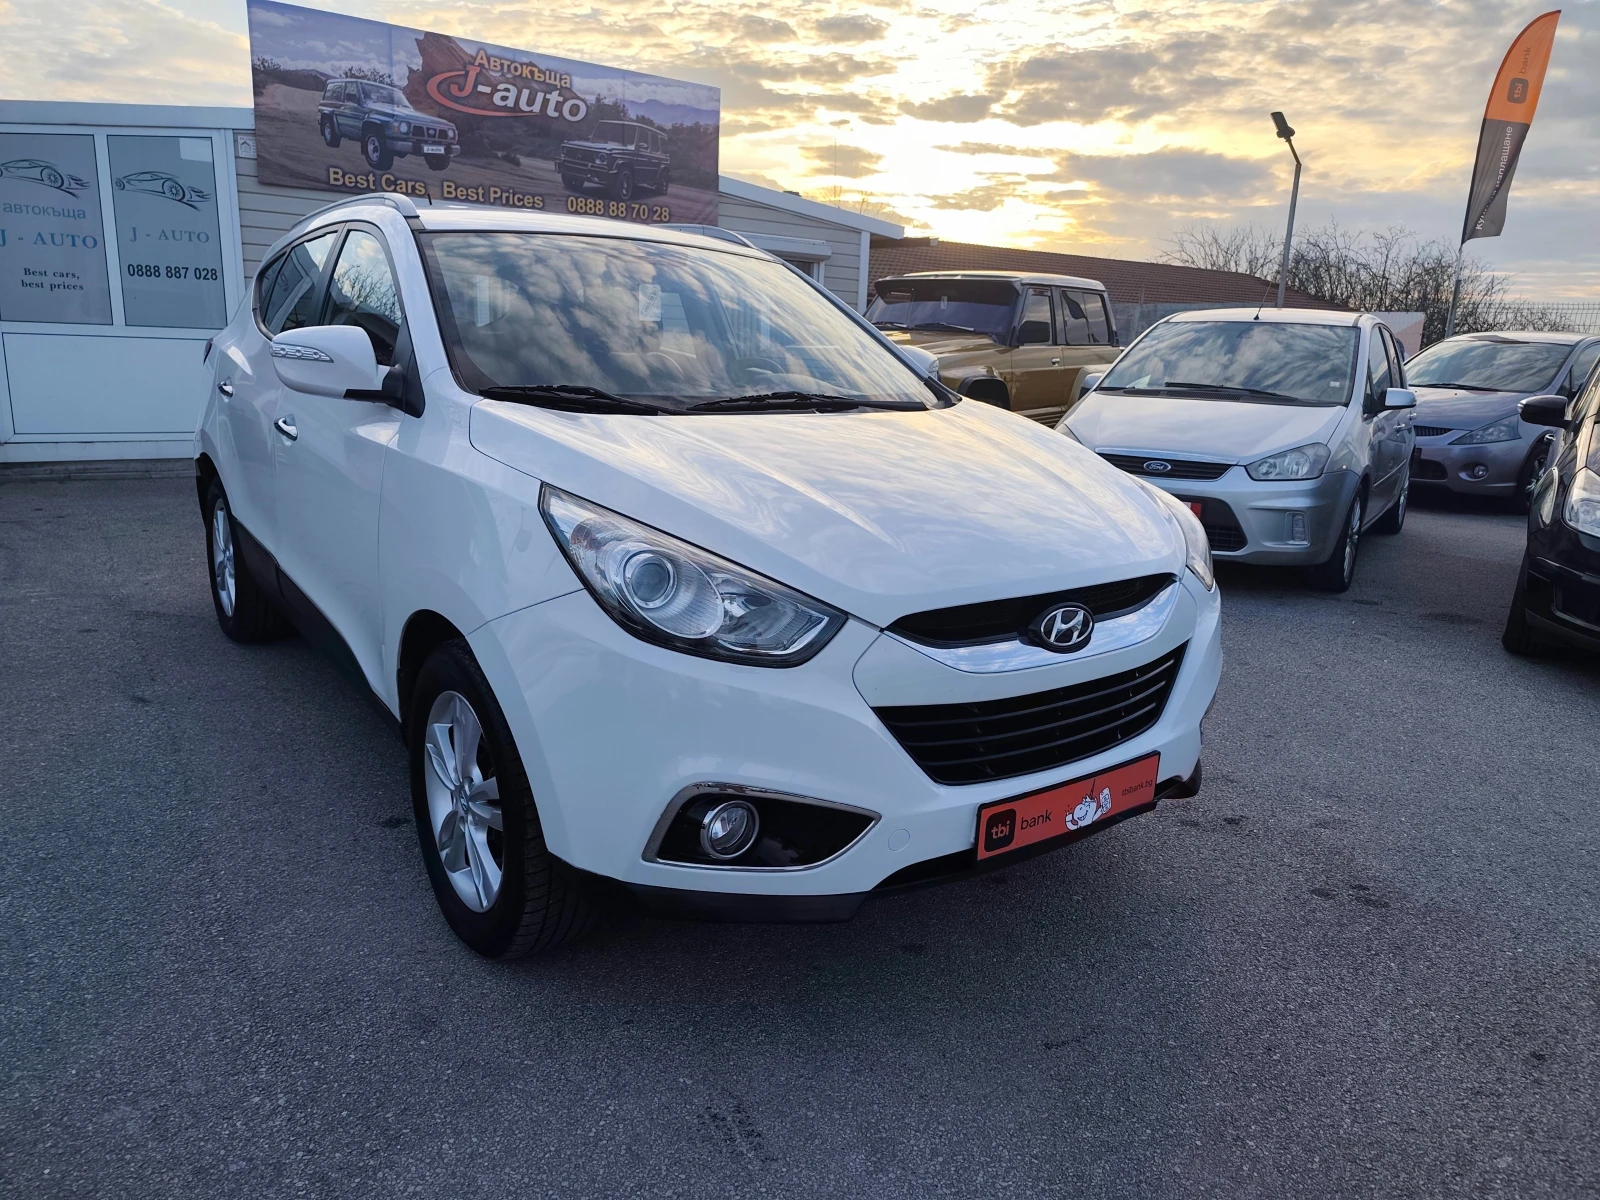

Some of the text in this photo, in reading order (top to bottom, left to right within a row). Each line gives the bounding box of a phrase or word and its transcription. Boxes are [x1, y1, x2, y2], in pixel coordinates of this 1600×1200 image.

[474, 50, 571, 89] Автокъща
[1519, 46, 1532, 74] bank
[450, 65, 587, 122] J-auto
[329, 168, 375, 190] Best
[443, 181, 485, 202] Best
[489, 187, 544, 208] Prices
[3, 202, 87, 220] автокъща
[567, 196, 670, 221] 0888 88 70 28
[33, 231, 98, 249] AUTO
[130, 226, 137, 242] J
[158, 229, 210, 244] AUTO
[23, 267, 80, 280] Best cars,
[127, 263, 218, 281] 0888 887 028
[21, 279, 84, 292] best prices
[991, 809, 1052, 839] tbi bank
